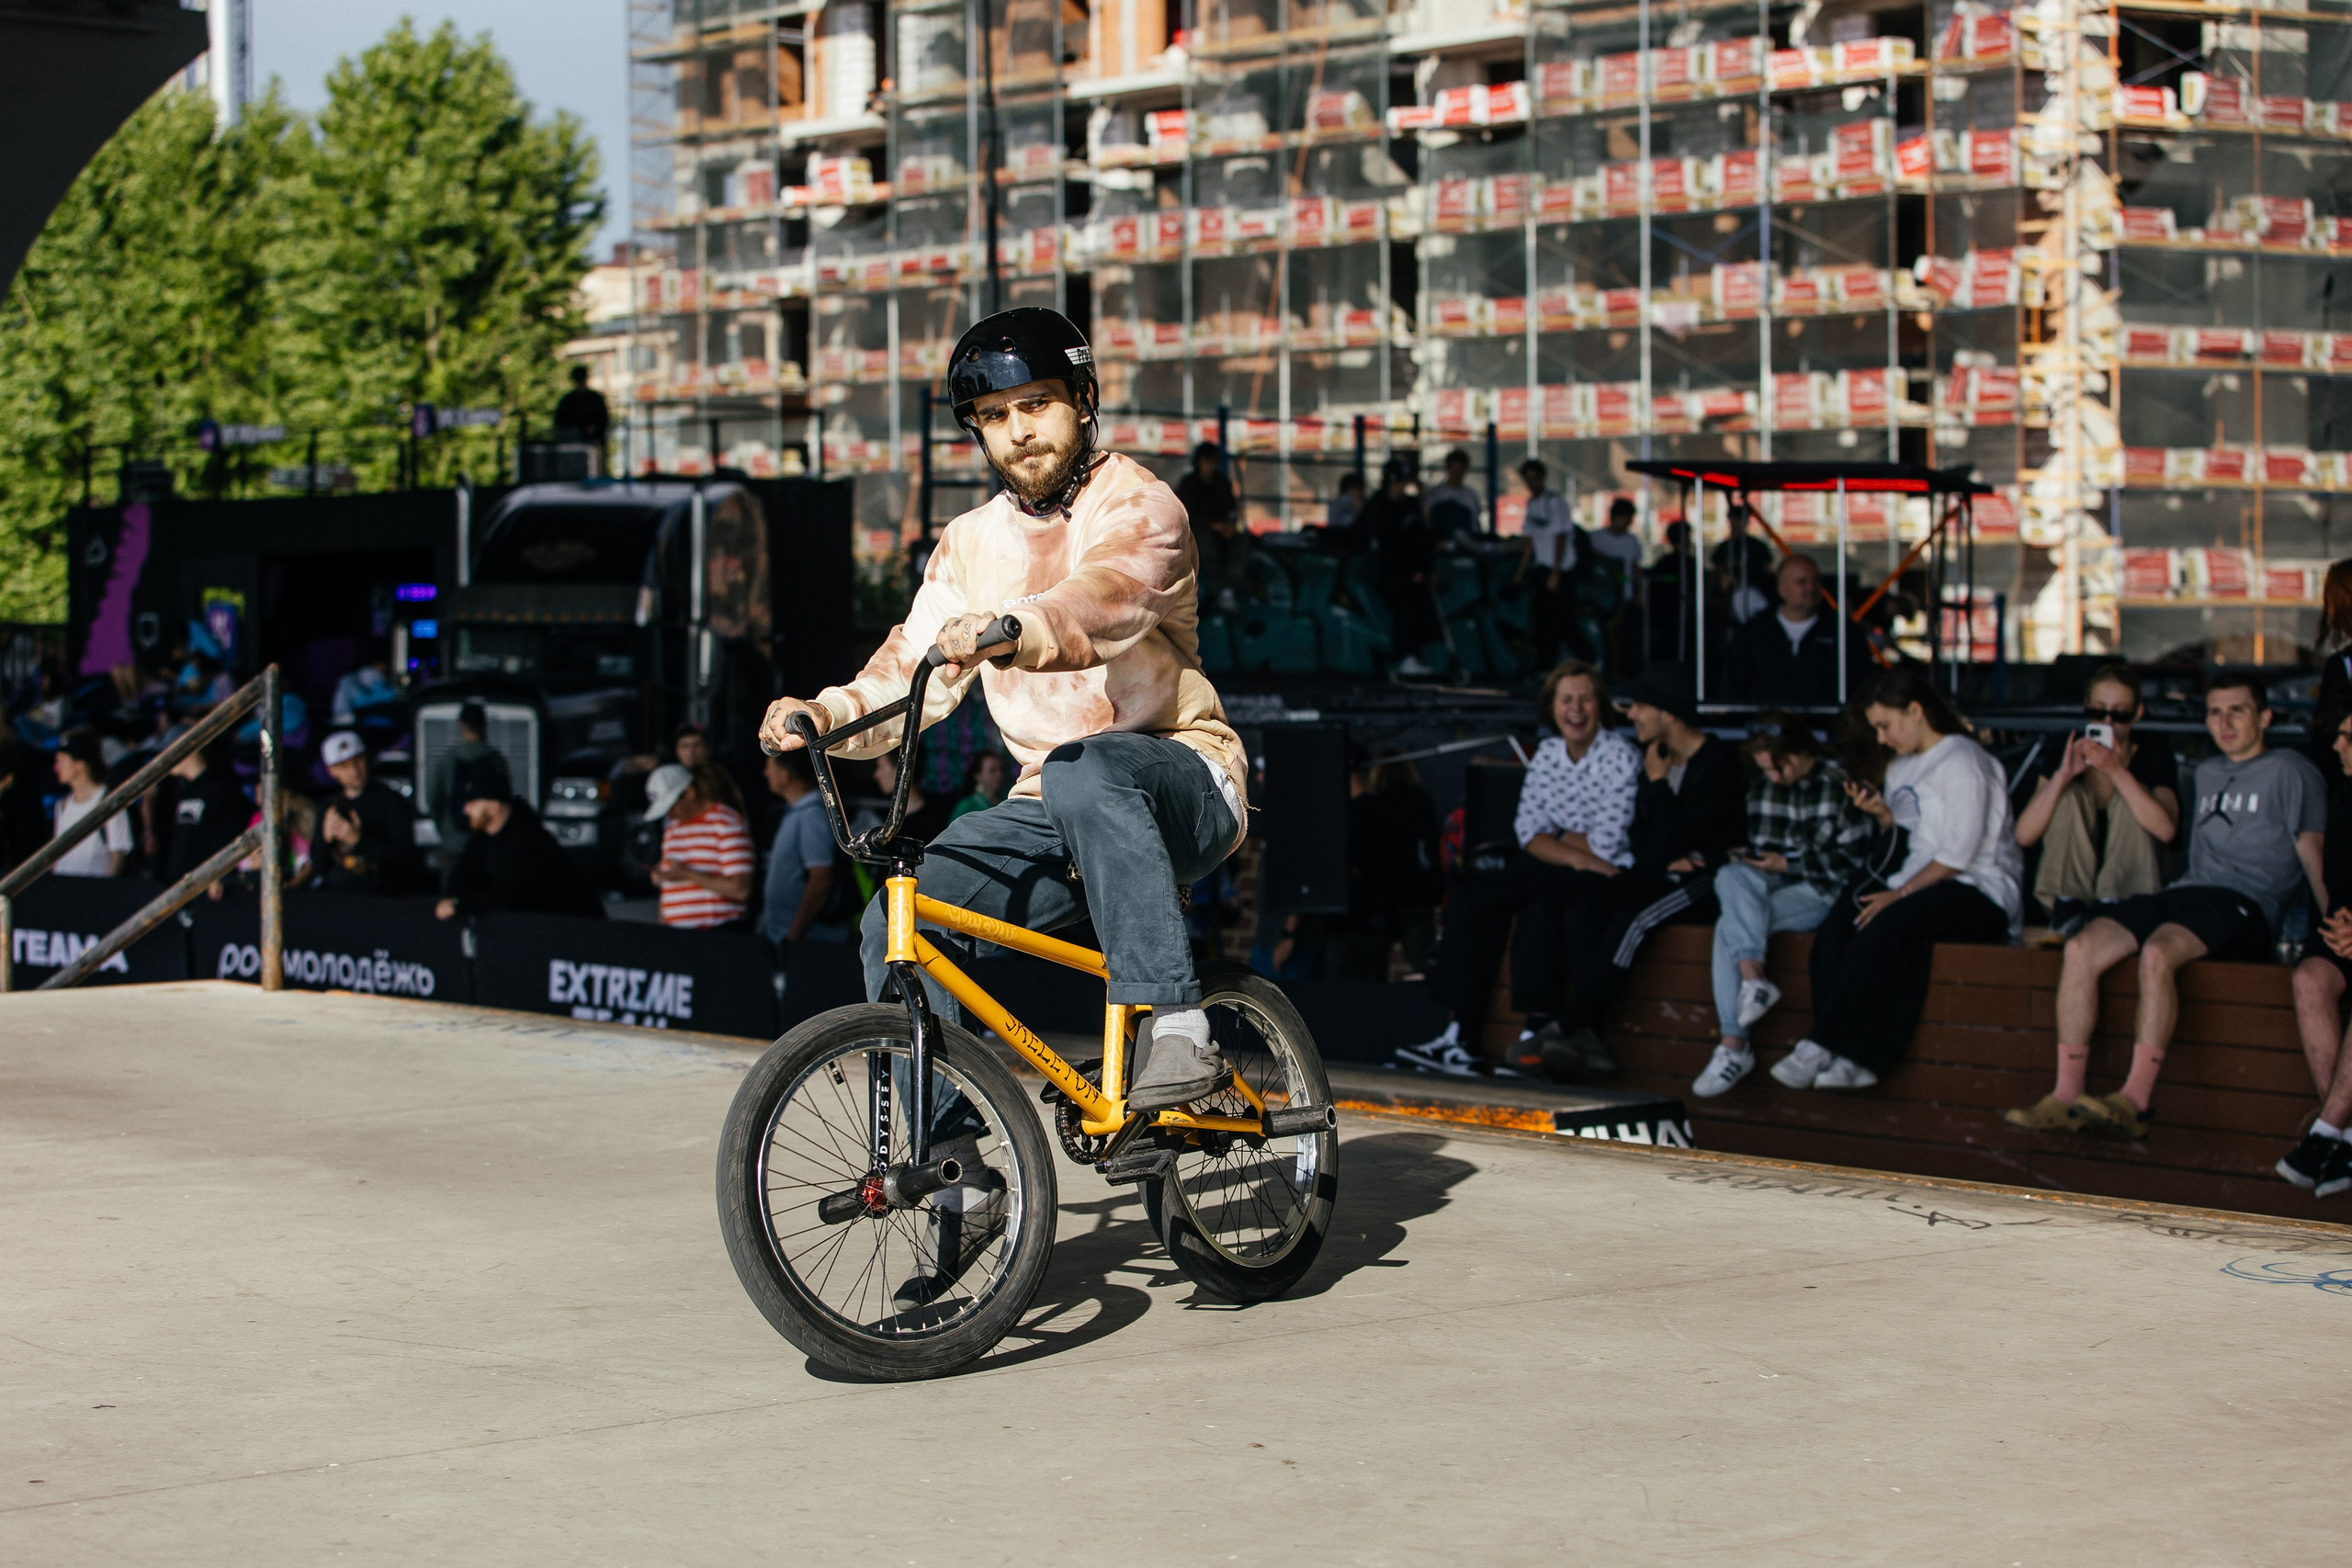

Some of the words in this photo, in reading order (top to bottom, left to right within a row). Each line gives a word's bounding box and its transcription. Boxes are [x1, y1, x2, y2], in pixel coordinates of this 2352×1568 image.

[217, 942, 435, 997] ромолодёжь
[548, 959, 693, 1019] EXTREME
[878, 1069, 890, 1172] ODYSSEY
